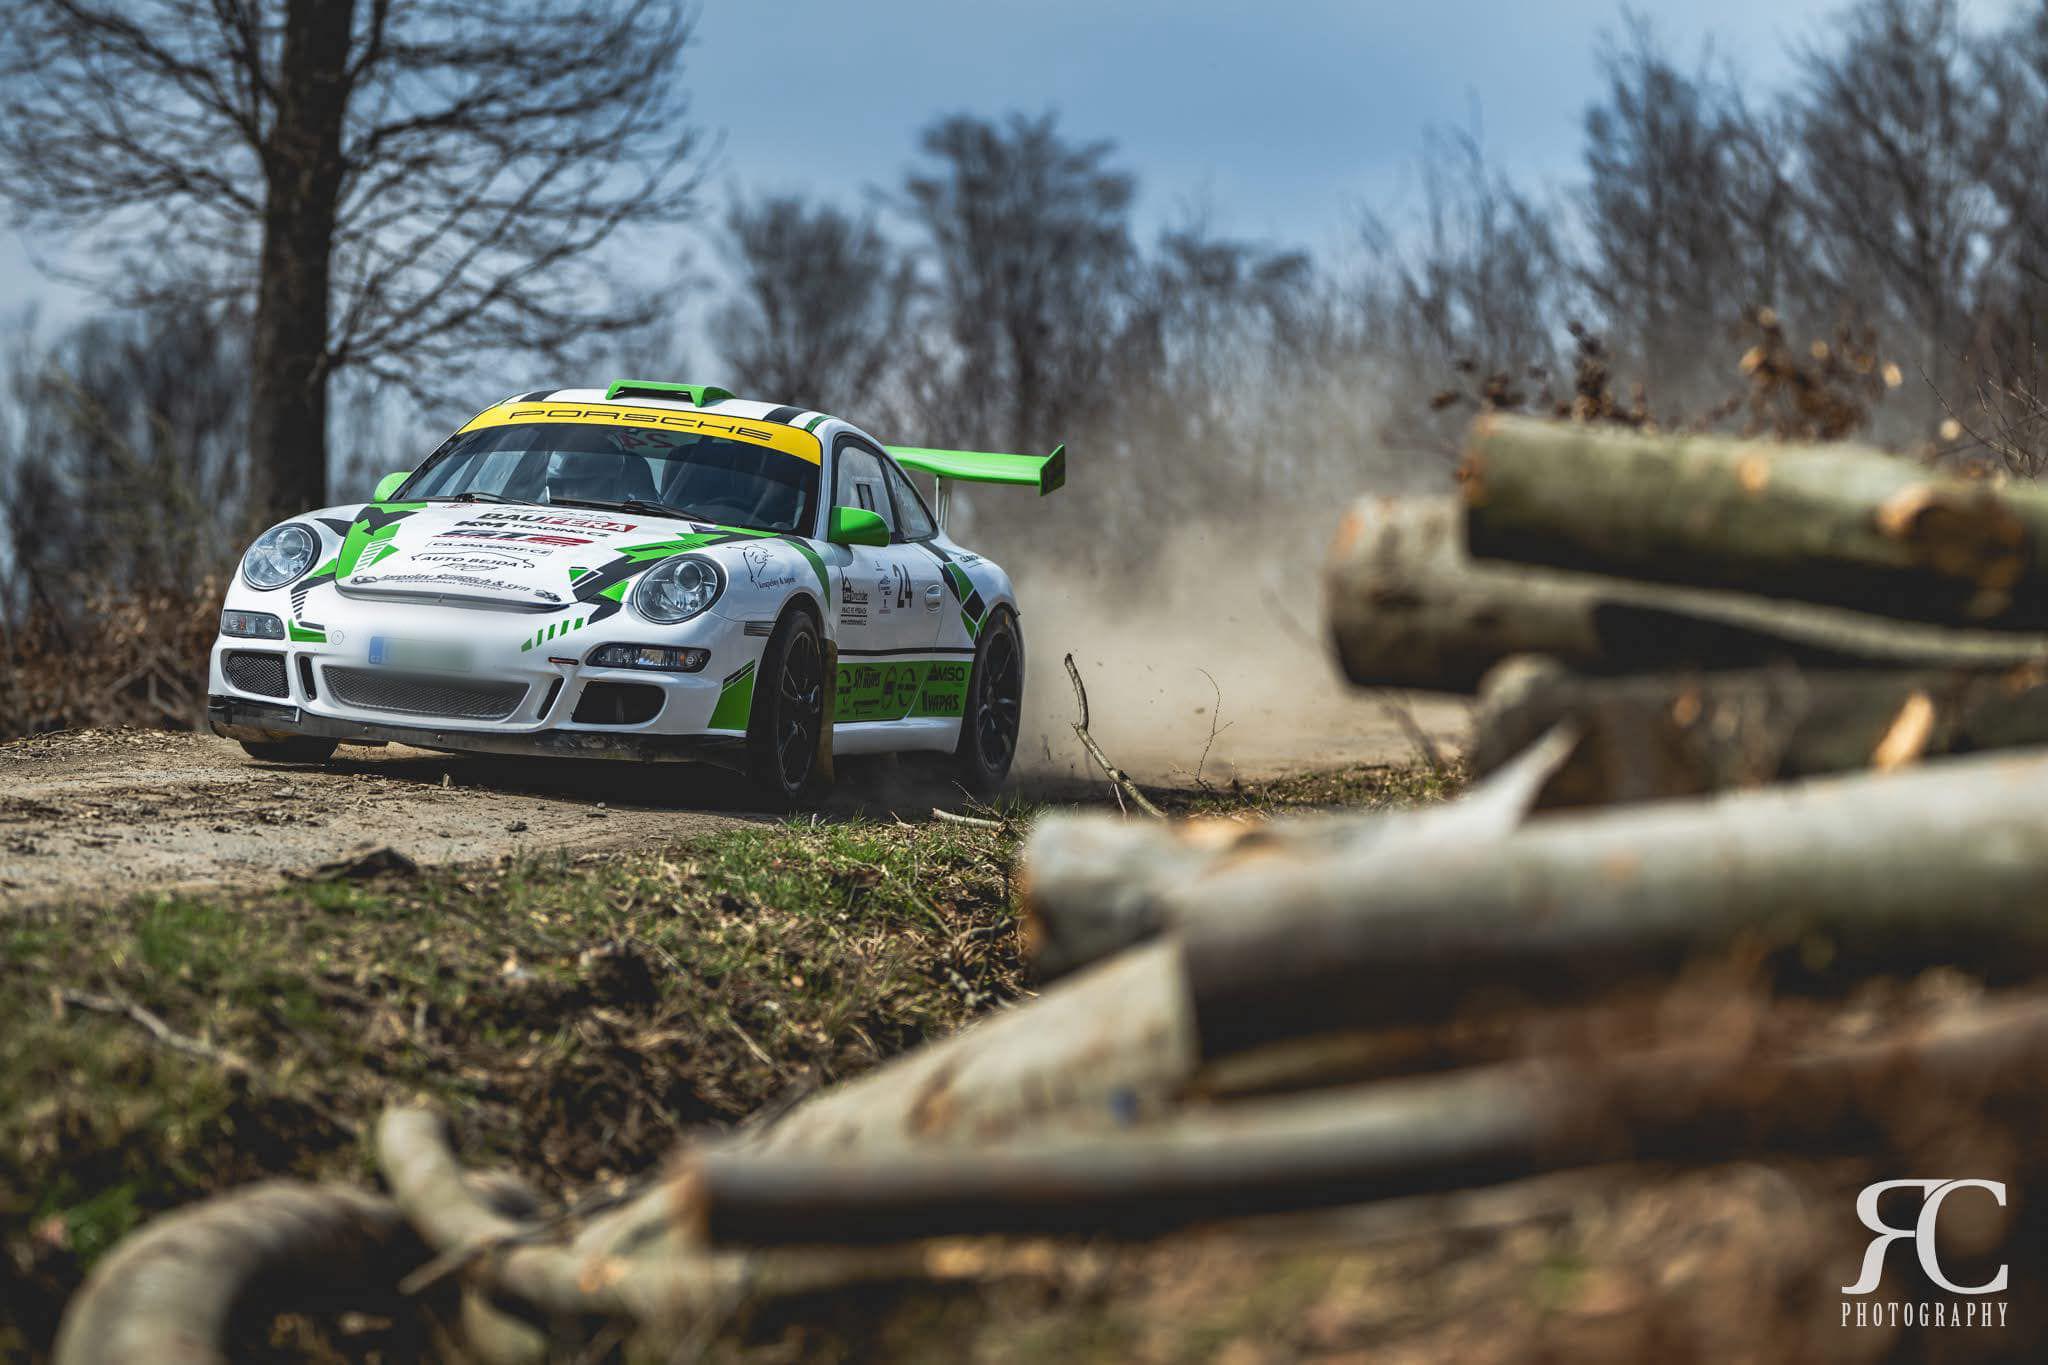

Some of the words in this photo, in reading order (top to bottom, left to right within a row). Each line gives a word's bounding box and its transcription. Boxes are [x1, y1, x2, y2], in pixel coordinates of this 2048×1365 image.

[509, 409, 774, 442] PORSCHE
[511, 523, 584, 535] TRADING
[422, 555, 467, 564] AUTO
[892, 563, 912, 608] 24
